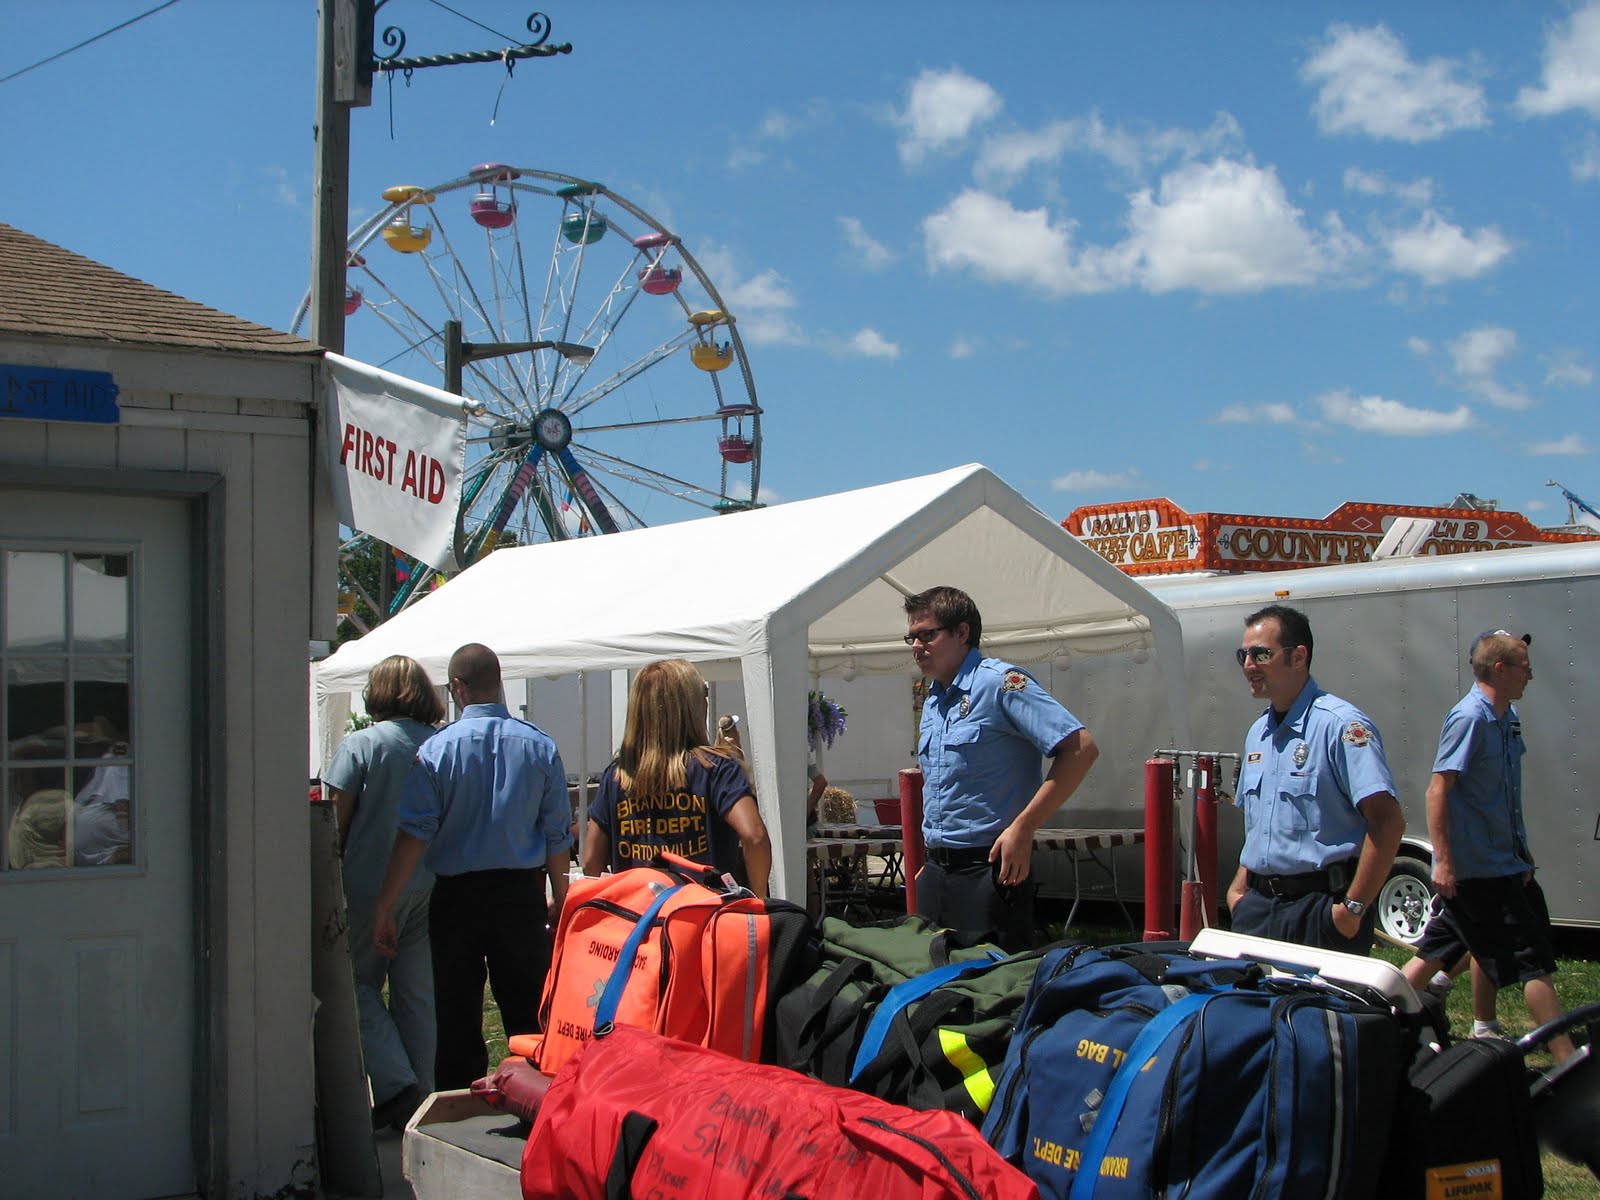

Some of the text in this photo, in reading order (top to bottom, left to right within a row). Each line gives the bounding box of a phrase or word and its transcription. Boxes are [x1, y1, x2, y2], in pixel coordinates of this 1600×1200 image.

[340, 422, 446, 505] FIRST AID
[1463, 521, 1479, 539] B
[1129, 530, 1189, 562] CAFE
[616, 792, 707, 820] BRANDON
[620, 815, 705, 836] FIRE DEPT.
[618, 834, 708, 861] ORTONVILLE
[1076, 1039, 1110, 1064] BAG
[1100, 1156, 1129, 1178] BRAND
[1444, 1181, 1493, 1198] LIFEPAK
